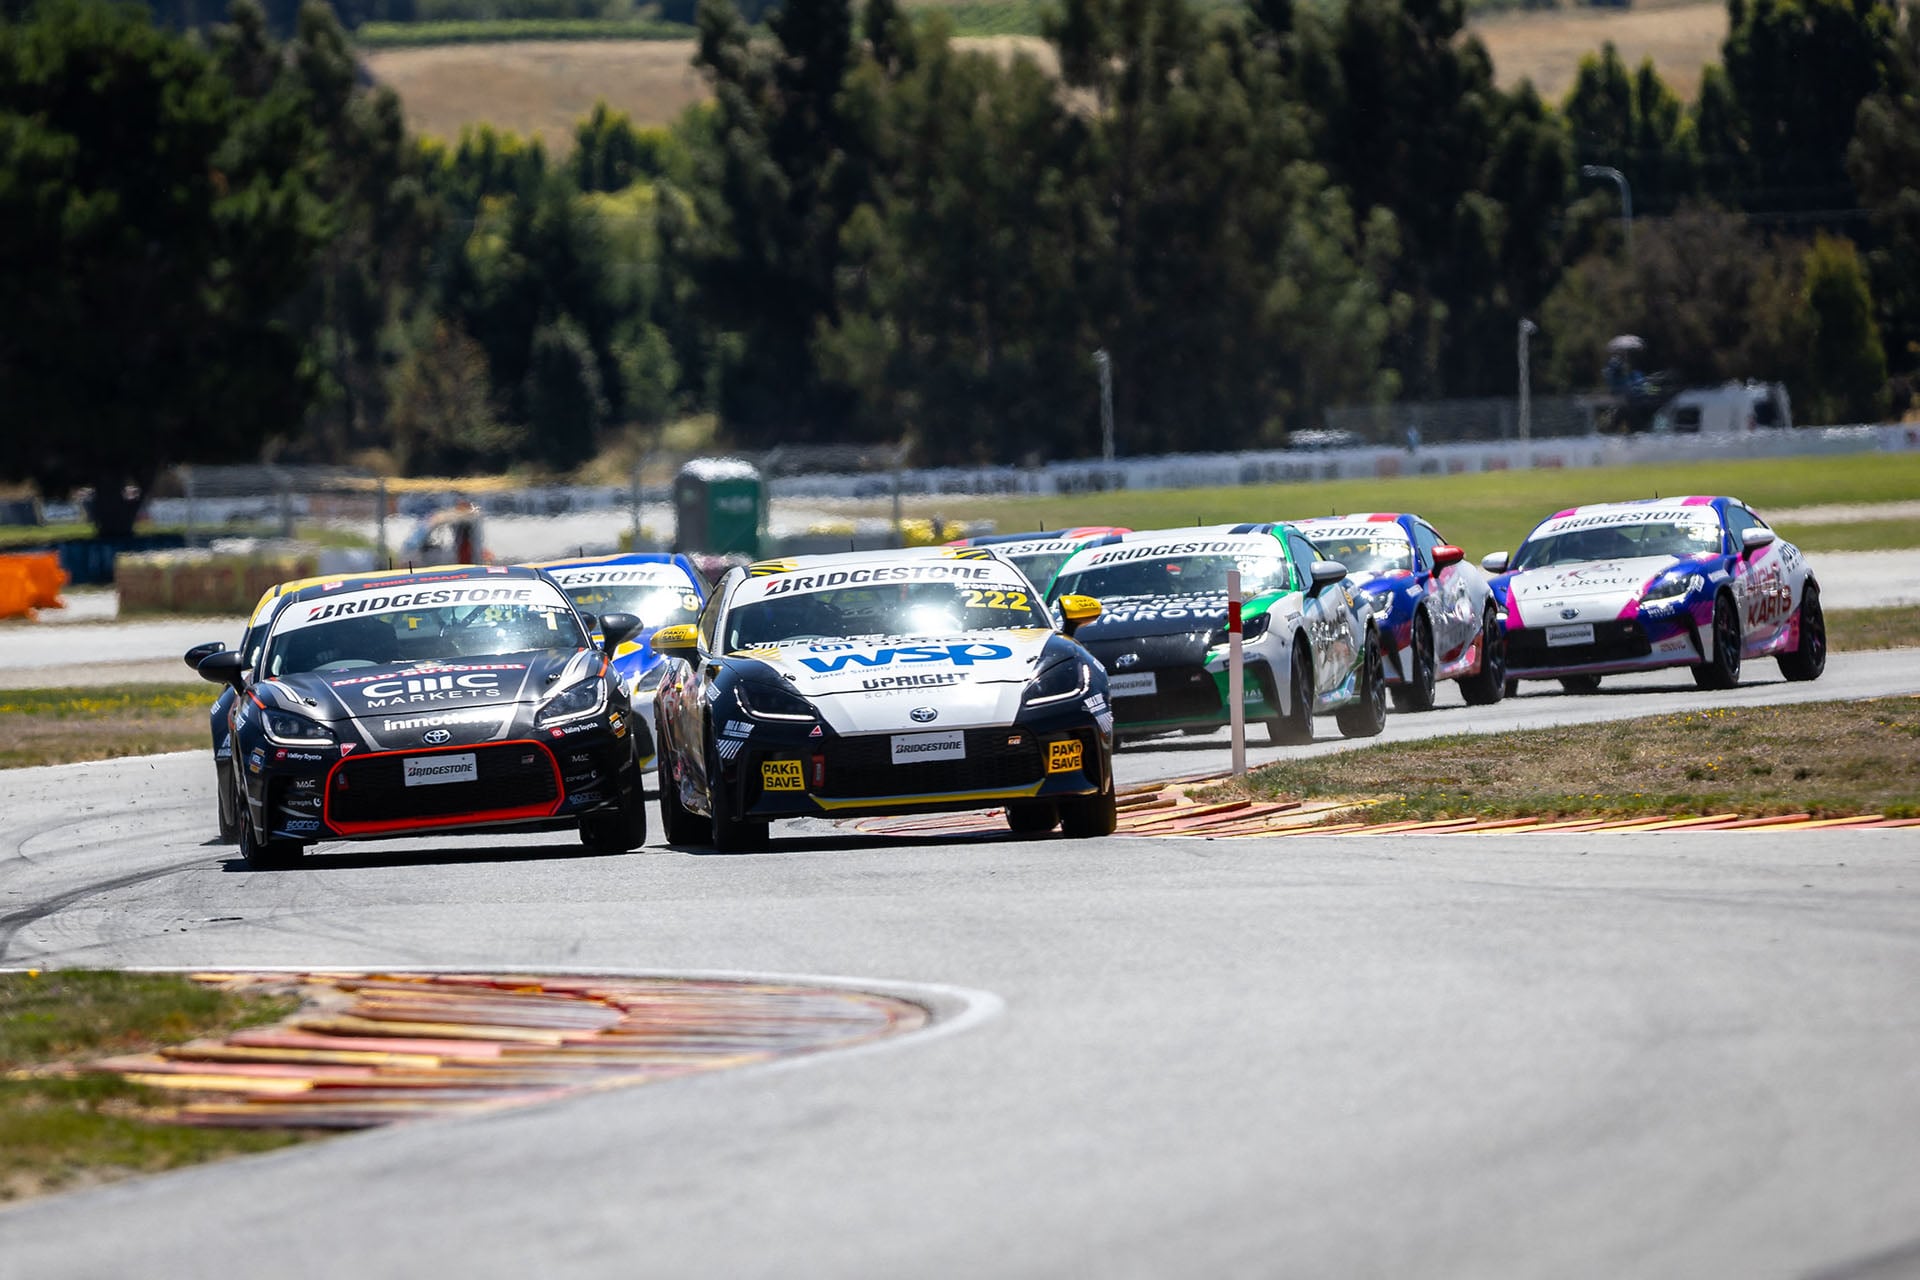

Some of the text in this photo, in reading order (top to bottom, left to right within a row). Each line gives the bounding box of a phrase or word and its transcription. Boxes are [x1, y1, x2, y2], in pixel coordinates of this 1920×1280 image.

[1550, 511, 1695, 532] BRIDGESTONE
[1089, 542, 1262, 566] BRIDGESTONE
[764, 567, 990, 596] BRIDGESTONE
[306, 589, 531, 622] BRIDGESTONE
[961, 590, 1032, 611] 222
[862, 672, 970, 689] UPRIGHT
[368, 689, 501, 708] MARKETS
[895, 741, 961, 754] BRIDGESTONE
[408, 763, 473, 777] BRIDGESTONE
[1052, 756, 1080, 770] SAVE
[766, 777, 801, 787] SAVE
